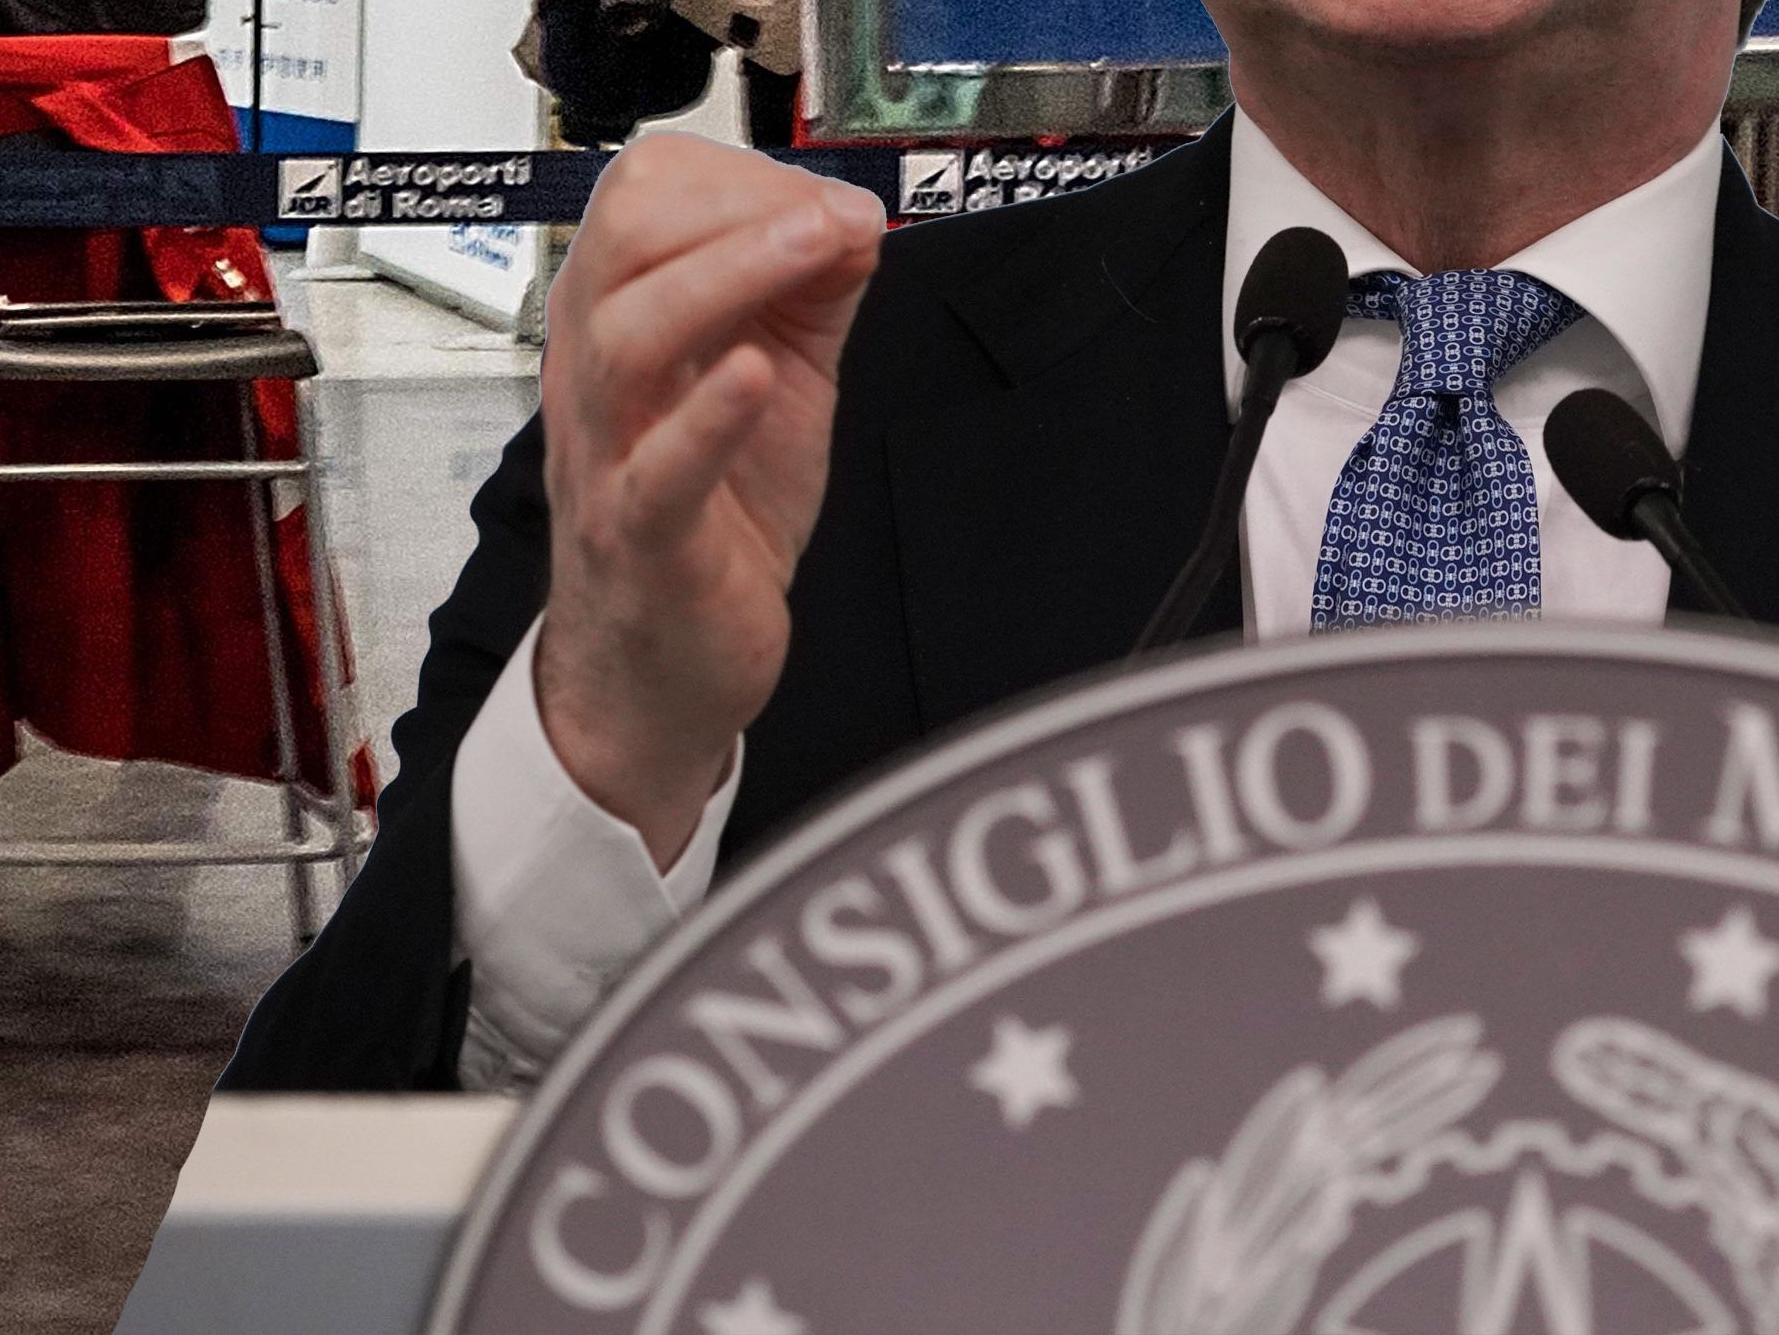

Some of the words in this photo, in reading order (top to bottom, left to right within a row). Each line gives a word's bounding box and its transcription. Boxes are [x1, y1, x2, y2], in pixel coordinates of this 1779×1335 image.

[344, 155, 532, 193] Aeroporti
[344, 190, 383, 219] di
[392, 189, 505, 219] Roma
[528, 699, 1373, 1314] CONSIGLIO
[1412, 712, 1658, 833] DEI
